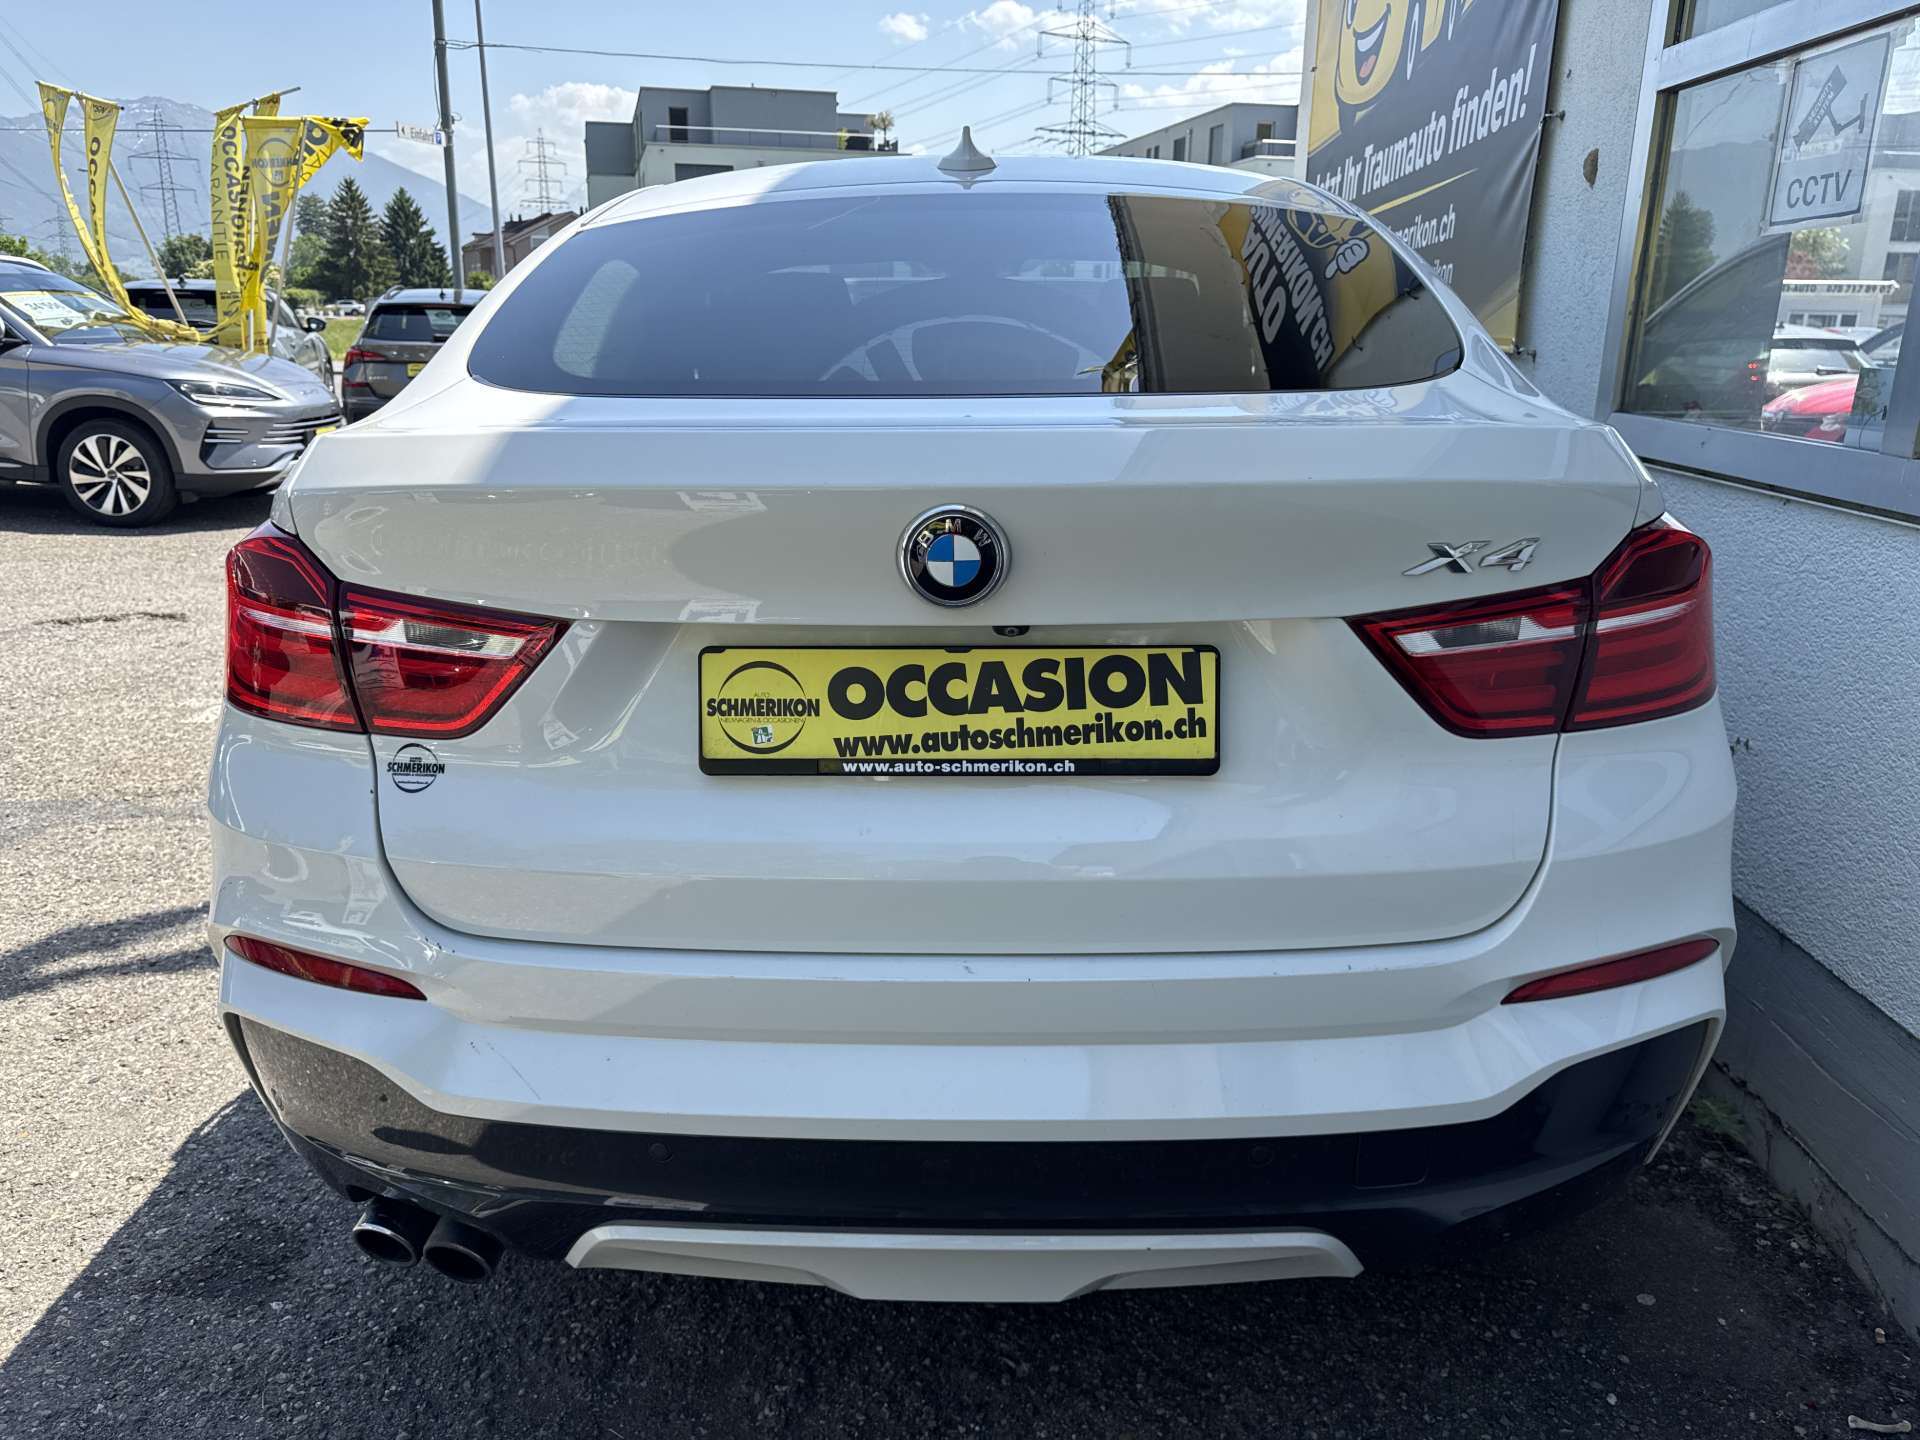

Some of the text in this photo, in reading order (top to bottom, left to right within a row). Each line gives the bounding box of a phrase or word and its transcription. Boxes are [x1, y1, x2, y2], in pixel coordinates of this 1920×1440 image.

[1341, 155, 1362, 201] Ihr
[1362, 110, 1446, 196] Traumauto
[1448, 42, 1537, 154] finden!
[1786, 168, 1852, 209] CCTV
[916, 518, 992, 549] BMW
[1401, 537, 1541, 577] X4
[827, 652, 1204, 721] OCCASION
[706, 697, 821, 718] SCHMERIKON
[833, 706, 1207, 758] www.autoschmerikon.ch
[386, 761, 446, 774] SCHMERIKON
[842, 758, 1076, 774] www.auto-schmerikon.ch
